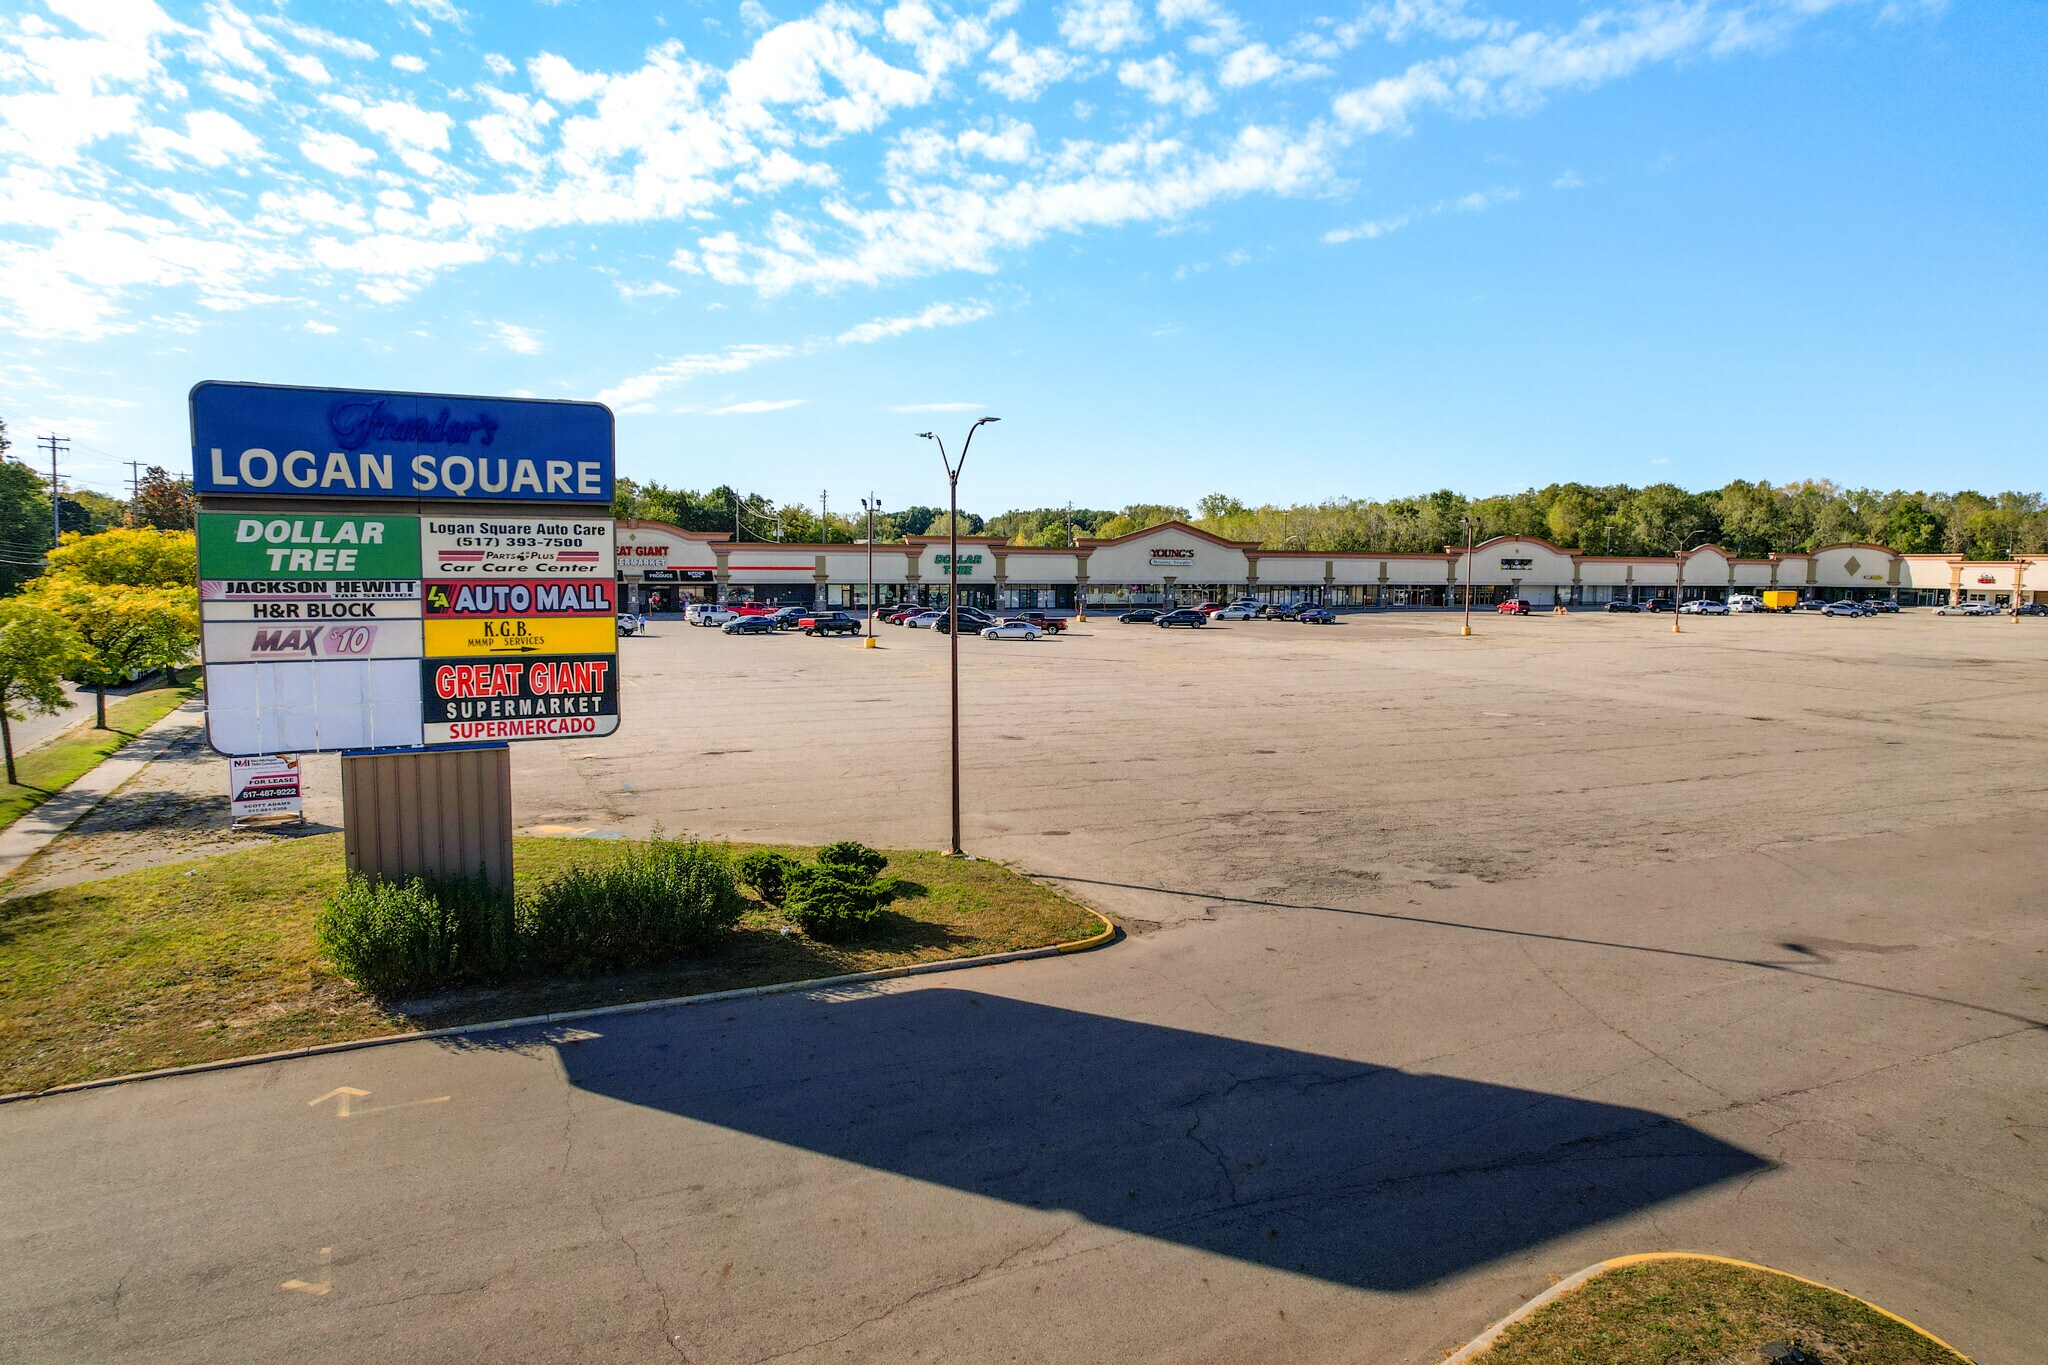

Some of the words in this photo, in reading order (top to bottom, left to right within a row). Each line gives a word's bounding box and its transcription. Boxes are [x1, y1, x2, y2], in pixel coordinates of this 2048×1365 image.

[211, 448, 393, 490] LOGAN
[412, 455, 600, 496] SQUARE
[236, 519, 385, 544] DOLLAR
[429, 522, 474, 536] Logan
[480, 522, 531, 536] Square
[536, 523, 568, 536] Auto
[573, 524, 605, 536] Care
[457, 537, 499, 547] (517)
[506, 537, 583, 547] 393-7500
[635, 546, 669, 556] GIANT
[1151, 549, 1194, 557] YOUNG'S
[266, 549, 358, 572] TREE
[935, 555, 982, 564] DOLAR
[440, 563, 475, 572] Car
[482, 563, 528, 572] Care
[536, 563, 597, 572] Center
[943, 565, 973, 575] TEE
[225, 581, 327, 594] JACKSON
[335, 581, 417, 593] HEWITT
[454, 585, 530, 611] AUTO
[537, 585, 610, 611] MALL
[253, 603, 299, 618] H&R
[307, 602, 376, 618] BLOCK
[484, 621, 532, 637] K.G.B.
[251, 625, 324, 656] MAX
[468, 638, 494, 647] MMMP
[504, 637, 544, 646] SERVICES
[436, 664, 523, 699] GREAT
[529, 661, 608, 695] GIANT
[446, 696, 602, 719] SUPERMARKET
[450, 717, 595, 739] SUPERMERCADO
[234, 759, 250, 767] NAI
[243, 788, 297, 798] 517-487-9222
